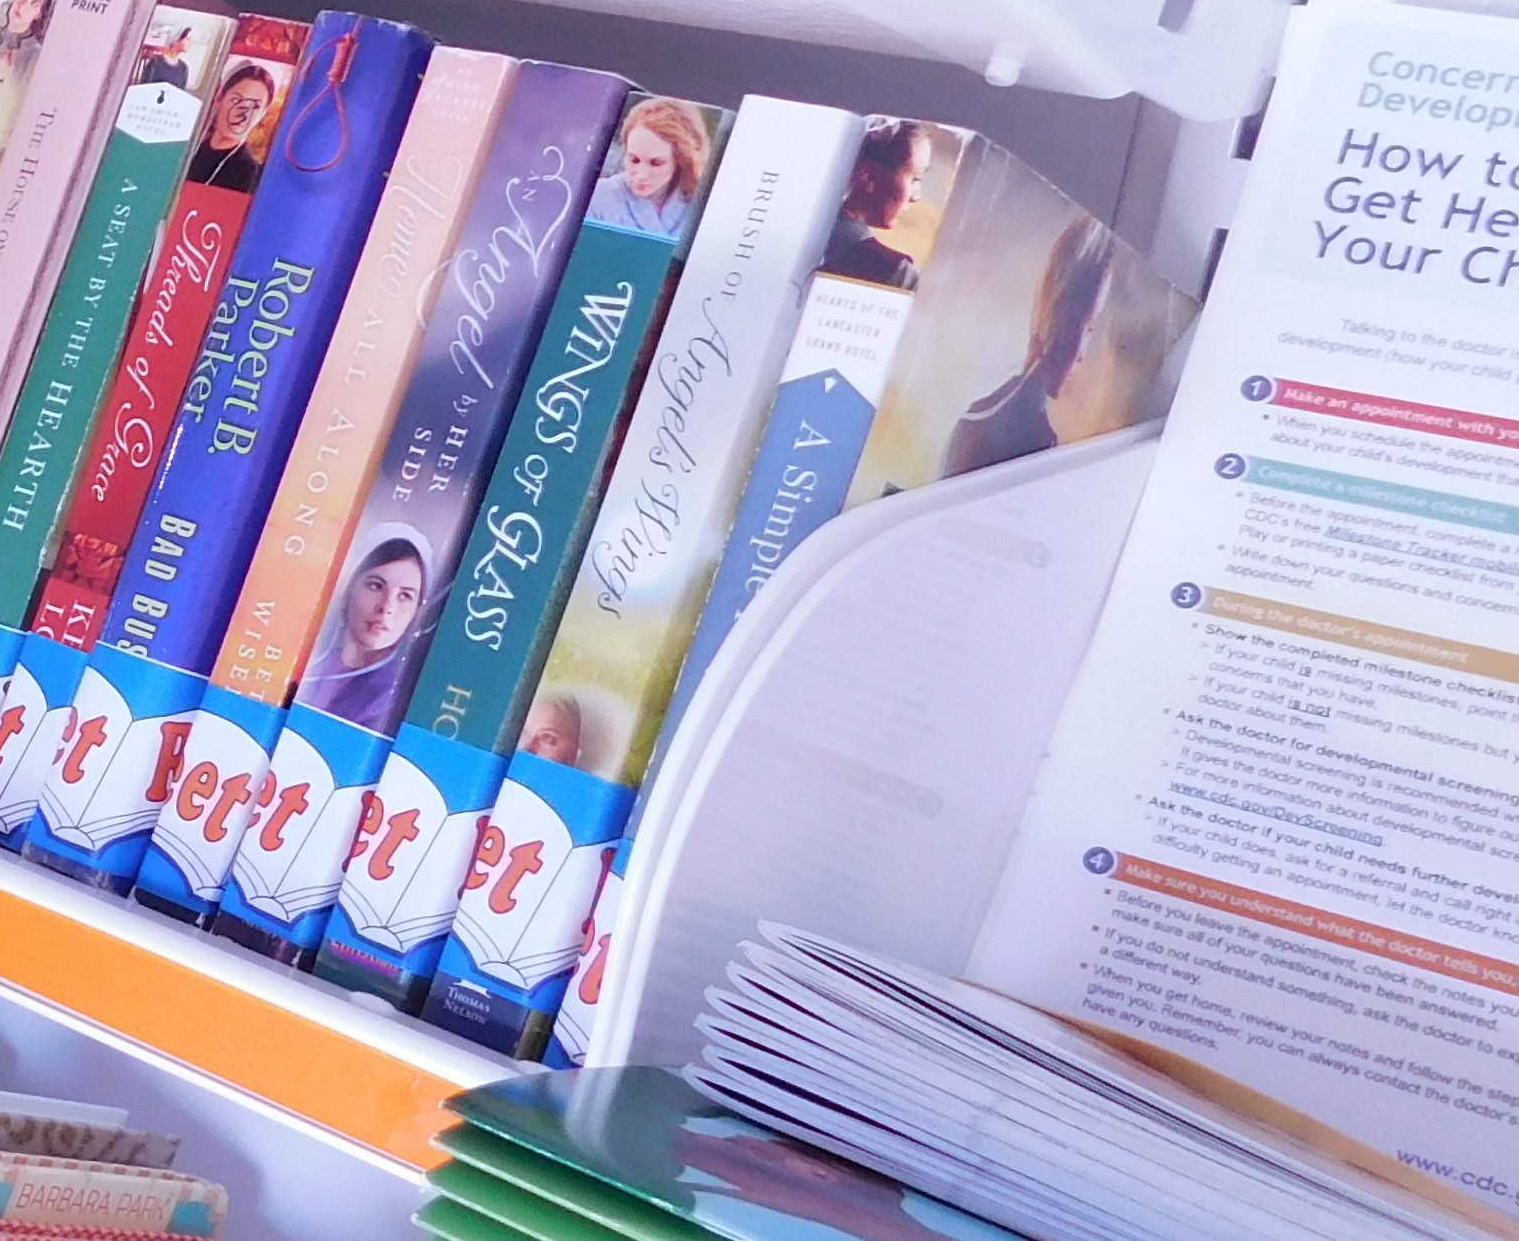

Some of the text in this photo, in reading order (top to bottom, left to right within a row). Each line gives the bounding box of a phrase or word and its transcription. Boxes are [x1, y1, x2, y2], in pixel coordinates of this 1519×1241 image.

[27, 107, 59, 151] THE
[1336, 127, 1465, 180] How
[4, 156, 41, 225] HOUSE
[1323, 175, 1423, 226] Get
[143, 207, 224, 349] Threads
[448, 145, 575, 391] Angel
[1312, 220, 1443, 276] Your
[0, 199, 133, 533] SEAT BY THE HEARTH
[125, 355, 157, 412] of
[186, 273, 261, 426] Parker
[206, 256, 317, 459] Robert B.
[591, 170, 781, 619] BRUSH OF Angel's Wings
[1284, 388, 1326, 405] Make
[1351, 400, 1454, 430] appointment
[1457, 419, 1495, 436] with
[90, 400, 155, 504] Grace
[282, 306, 386, 558] ALL ALONG
[392, 425, 432, 504] SIDE
[428, 423, 470, 494] HER
[464, 280, 635, 653] WINGS GLASS
[792, 418, 834, 452] A
[142, 511, 199, 584] BAD
[1387, 937, 1442, 962] doctor
[443, 996, 488, 1027] NELSON
[447, 985, 491, 1016] THOMAS
[16, 1182, 113, 1212] BARBARA
